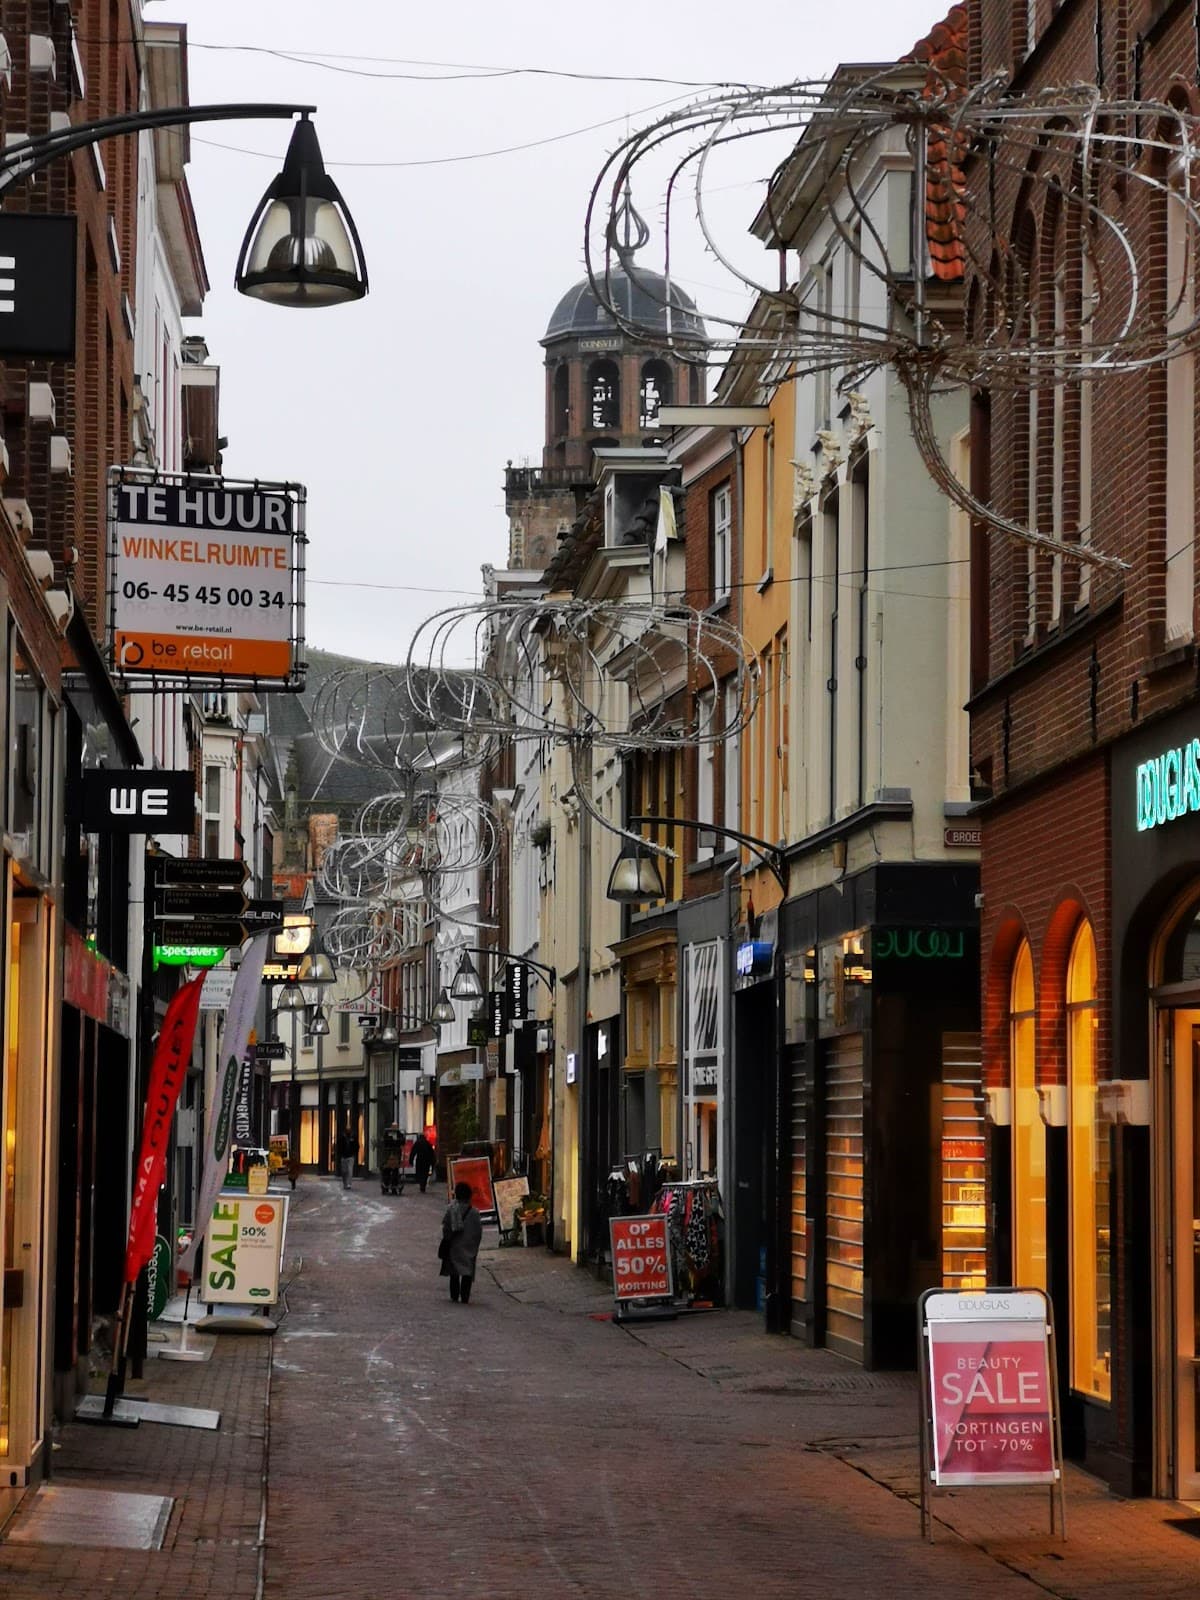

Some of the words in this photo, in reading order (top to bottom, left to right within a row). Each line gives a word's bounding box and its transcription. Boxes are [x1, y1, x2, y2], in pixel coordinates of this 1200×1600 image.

[121, 485, 167, 522] TE
[179, 490, 287, 531] HUUR
[122, 536, 287, 569] WINKELRUIMTE
[123, 580, 158, 600] 06-
[163, 583, 189, 603] 45
[195, 586, 221, 605] 45
[227, 588, 253, 607] 00
[258, 590, 285, 609] 34
[176, 623, 233, 635] www.be-retail.nl
[152, 639, 177, 657] be
[183, 641, 233, 661] retail
[110, 787, 169, 816] WE
[162, 945, 219, 957] Specsavers
[241, 1226, 267, 1238] 50%
[628, 1223, 651, 1236] OP
[209, 1201, 240, 1290] SALE
[616, 1237, 665, 1250] ALLES
[617, 1255, 666, 1275] 50%
[617, 1280, 667, 1292] KORTING
[958, 1298, 1011, 1311] DOUGLAS
[957, 1356, 1022, 1370] BEAUTY
[942, 1371, 1041, 1406] SALE
[944, 1420, 1043, 1435] KORTINGEN
[954, 1439, 987, 1453] TOT
